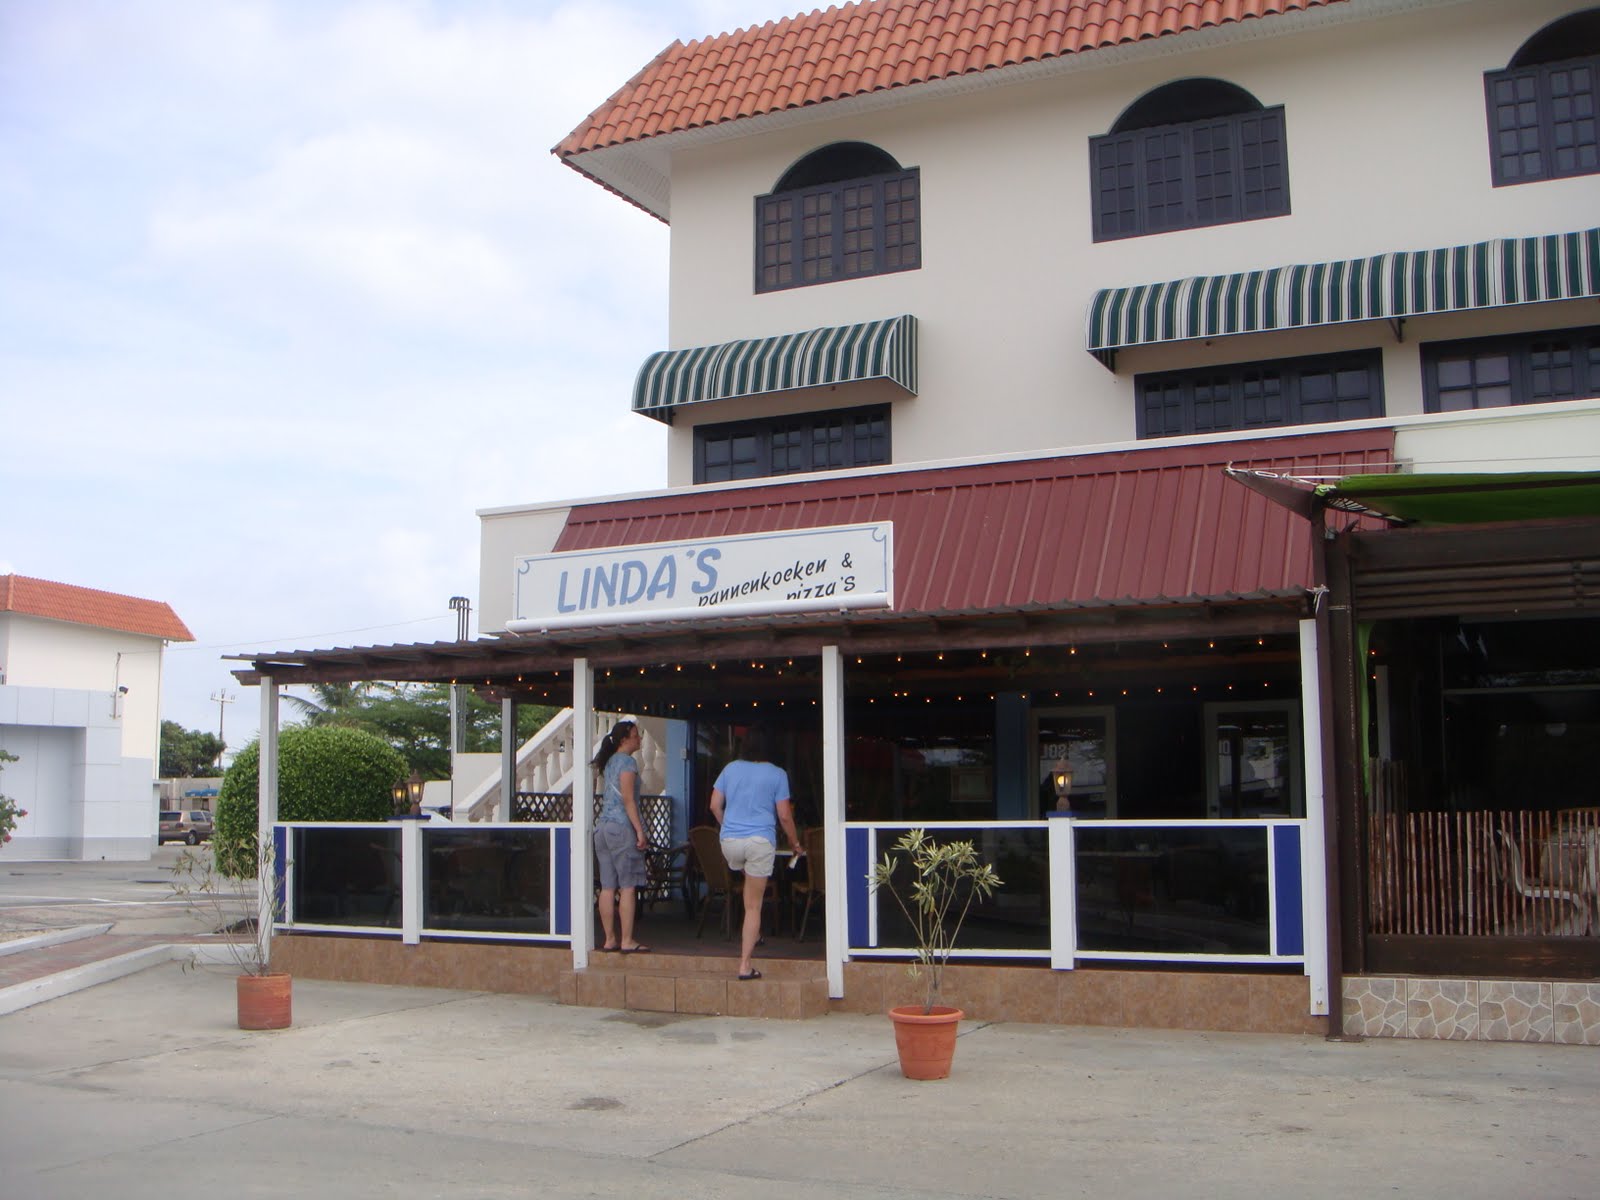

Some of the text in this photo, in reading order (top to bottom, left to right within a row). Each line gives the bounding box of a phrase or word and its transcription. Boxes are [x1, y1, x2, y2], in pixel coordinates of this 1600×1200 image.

[557, 547, 722, 614] LINDA'S
[698, 552, 853, 607] pannenkoeken &
